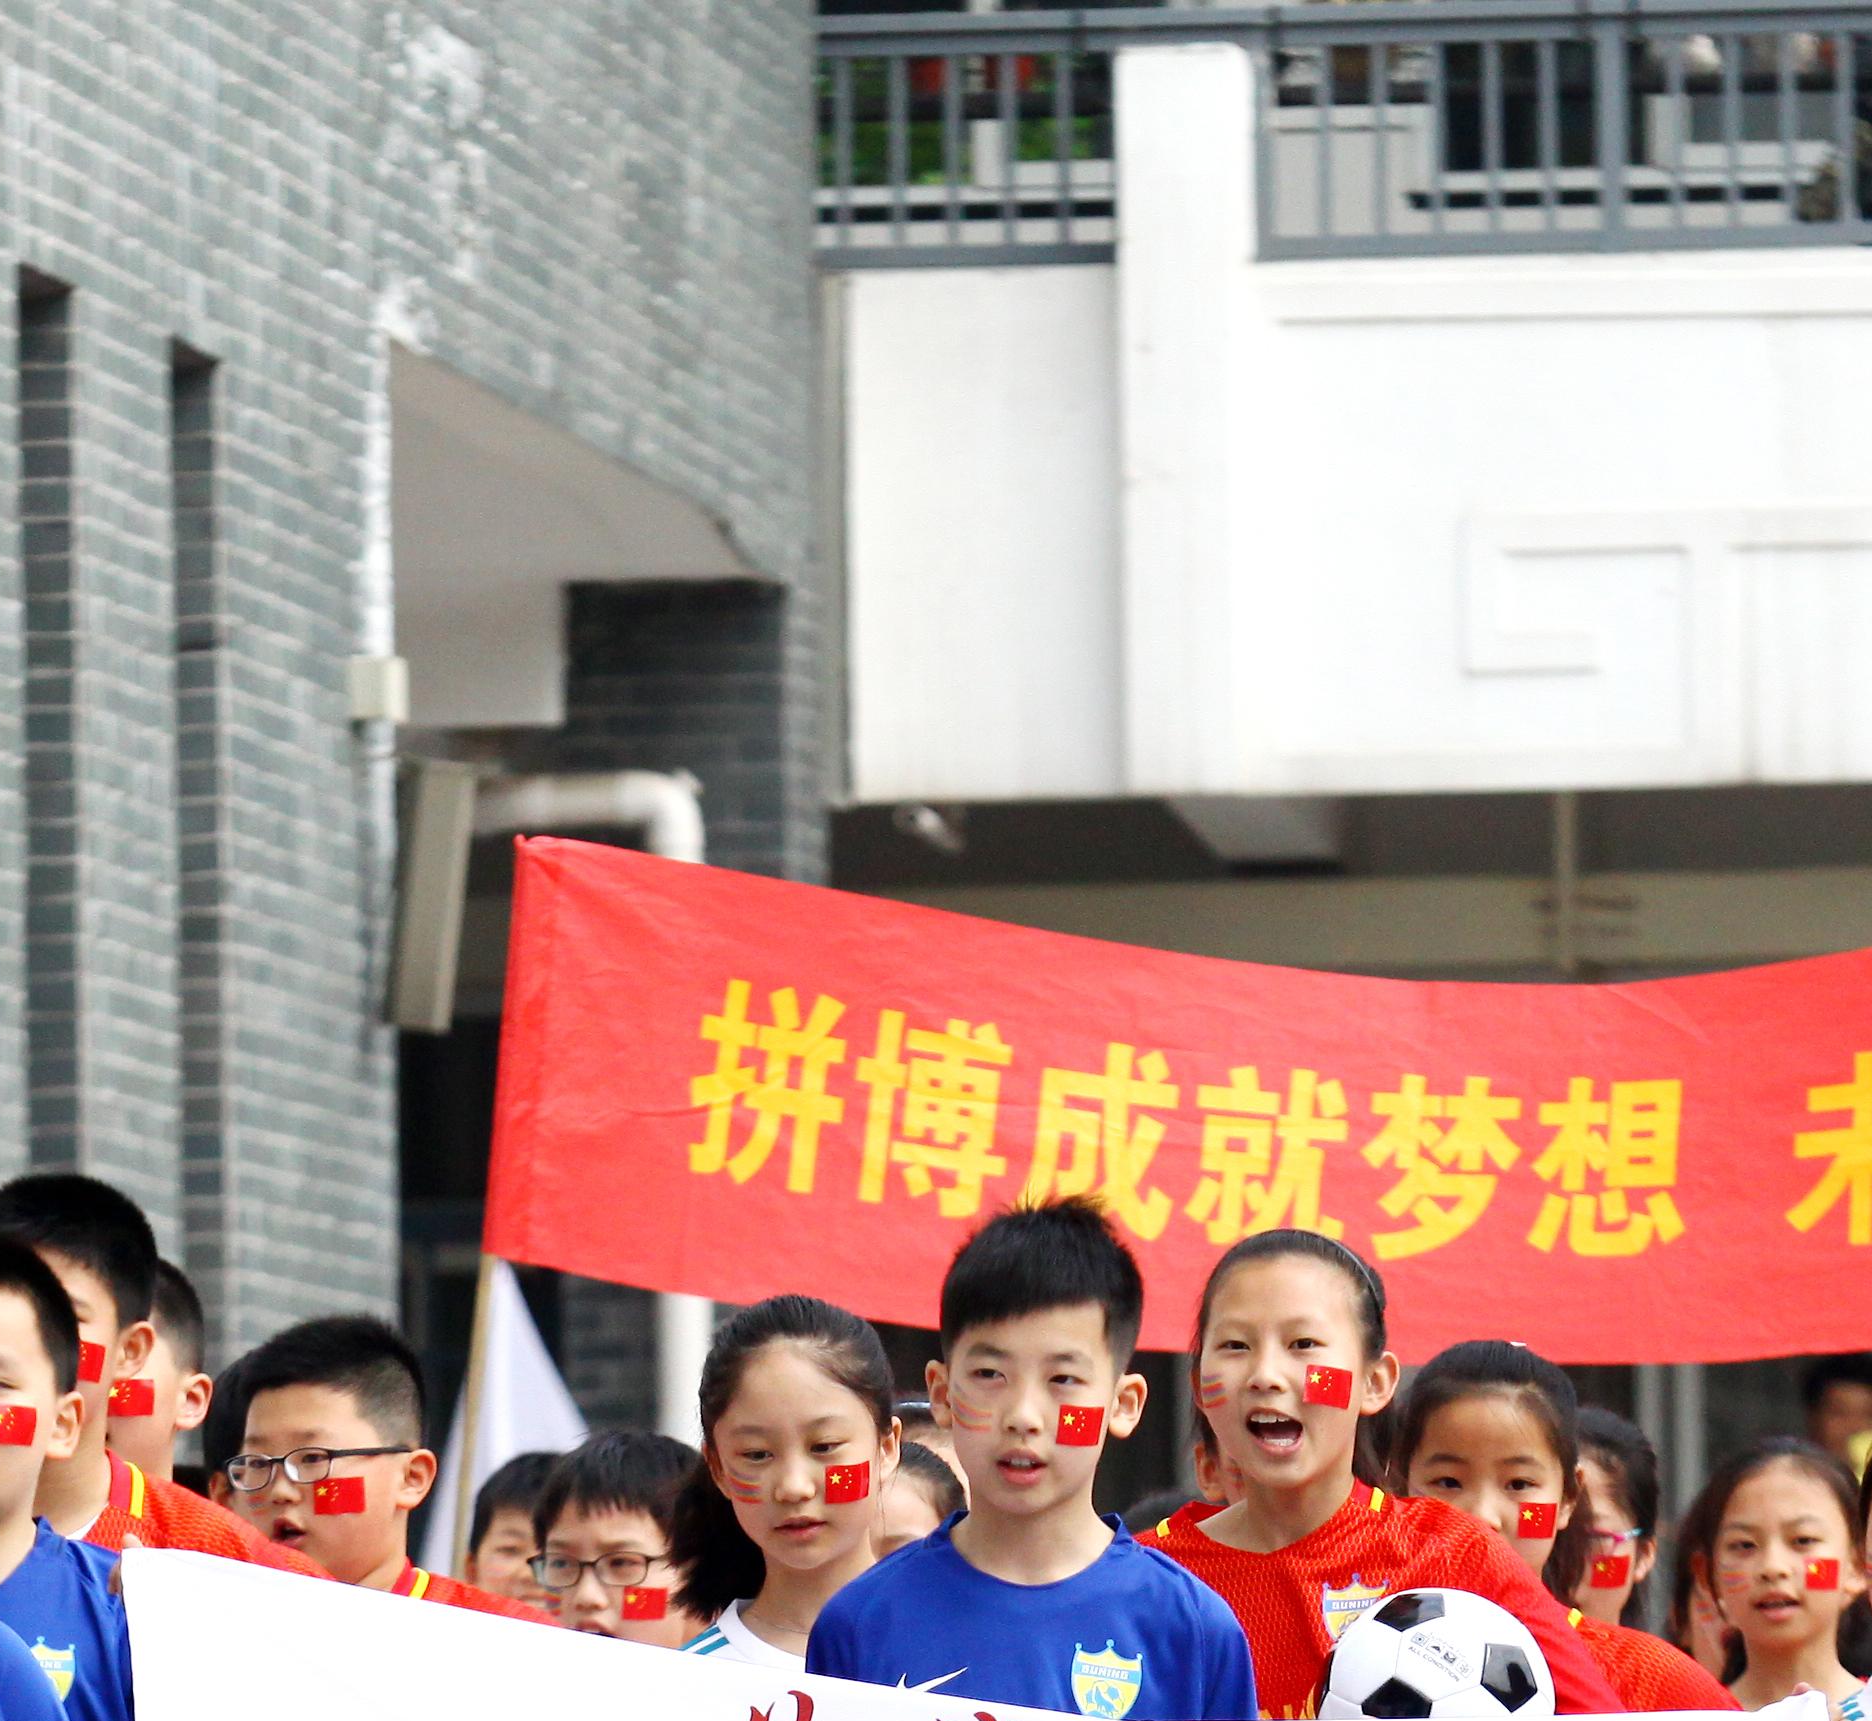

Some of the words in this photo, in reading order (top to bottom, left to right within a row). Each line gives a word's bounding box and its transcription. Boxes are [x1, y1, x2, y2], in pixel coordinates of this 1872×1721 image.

[686, 977, 1686, 1262] 拼博成就梦想
